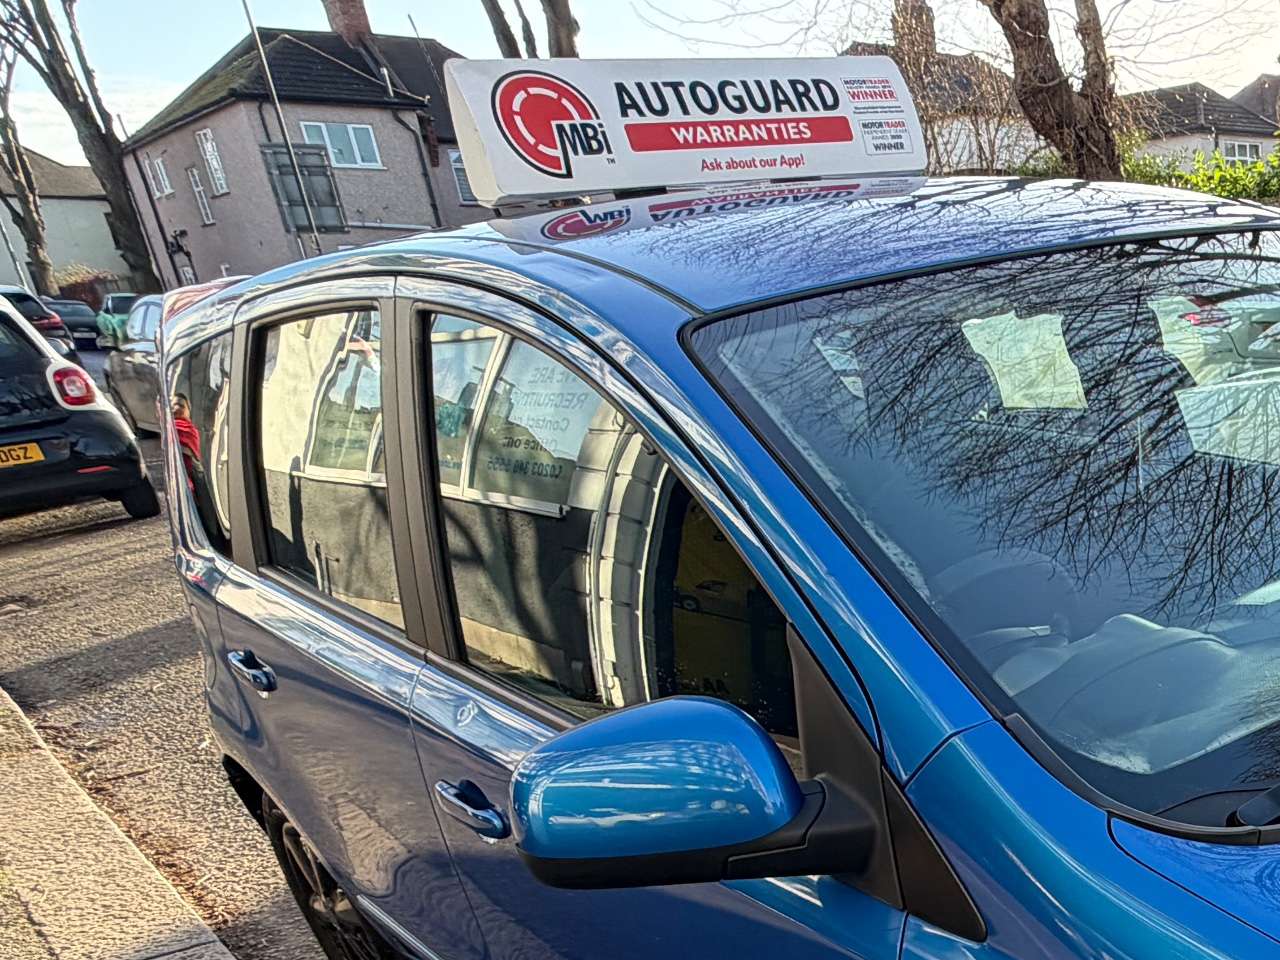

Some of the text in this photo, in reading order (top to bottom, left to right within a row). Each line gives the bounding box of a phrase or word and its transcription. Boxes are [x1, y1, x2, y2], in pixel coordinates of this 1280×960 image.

[614, 78, 840, 118] AUTOGUARD
[848, 90, 897, 101] WINNER
[670, 122, 812, 145] WARRANTIES
[872, 142, 905, 152] WINNER
[701, 153, 805, 172] Ask about our App!
